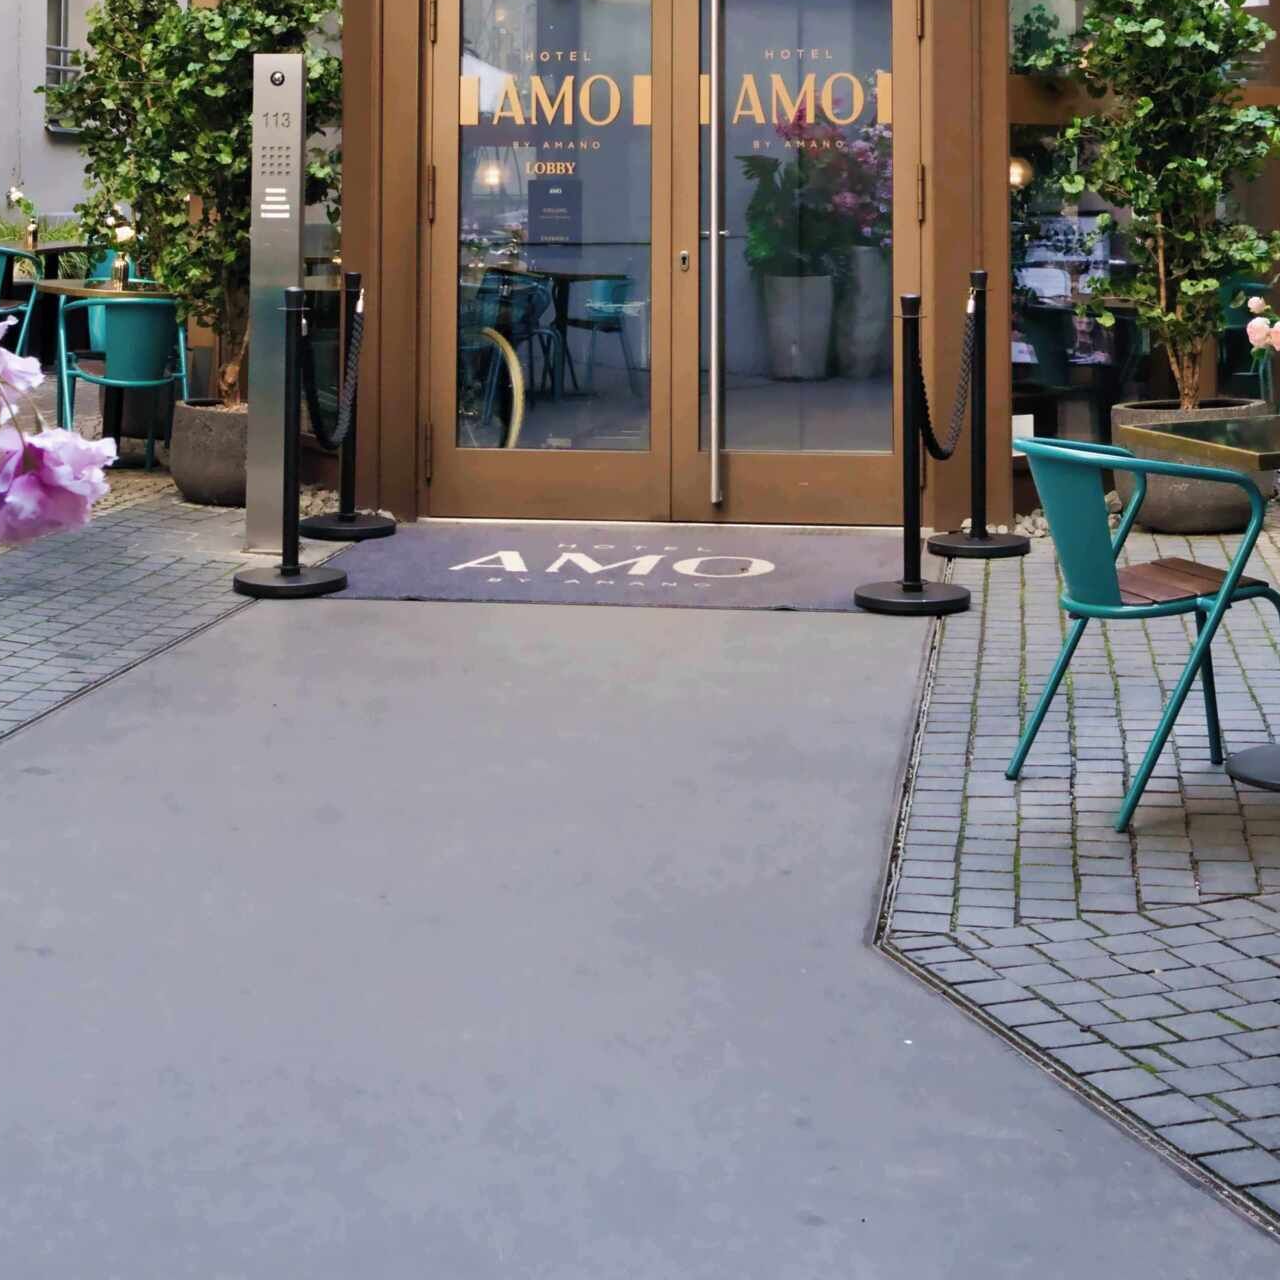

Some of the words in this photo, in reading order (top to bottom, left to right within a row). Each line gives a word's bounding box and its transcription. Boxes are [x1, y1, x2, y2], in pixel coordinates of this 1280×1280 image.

[525, 51, 593, 62] HOTEL
[764, 49, 833, 59] HOTEL
[492, 74, 621, 126] AMO
[732, 72, 865, 125] AMO
[262, 112, 291, 128] 113
[512, 141, 531, 150] BY
[542, 141, 601, 150] AMANO
[752, 140, 771, 149] BY
[784, 140, 844, 149] AMANO
[525, 162, 576, 175] LOBBY
[558, 543, 712, 552] HOTEL
[448, 550, 776, 578] AMO
[563, 578, 713, 587] AMANO
